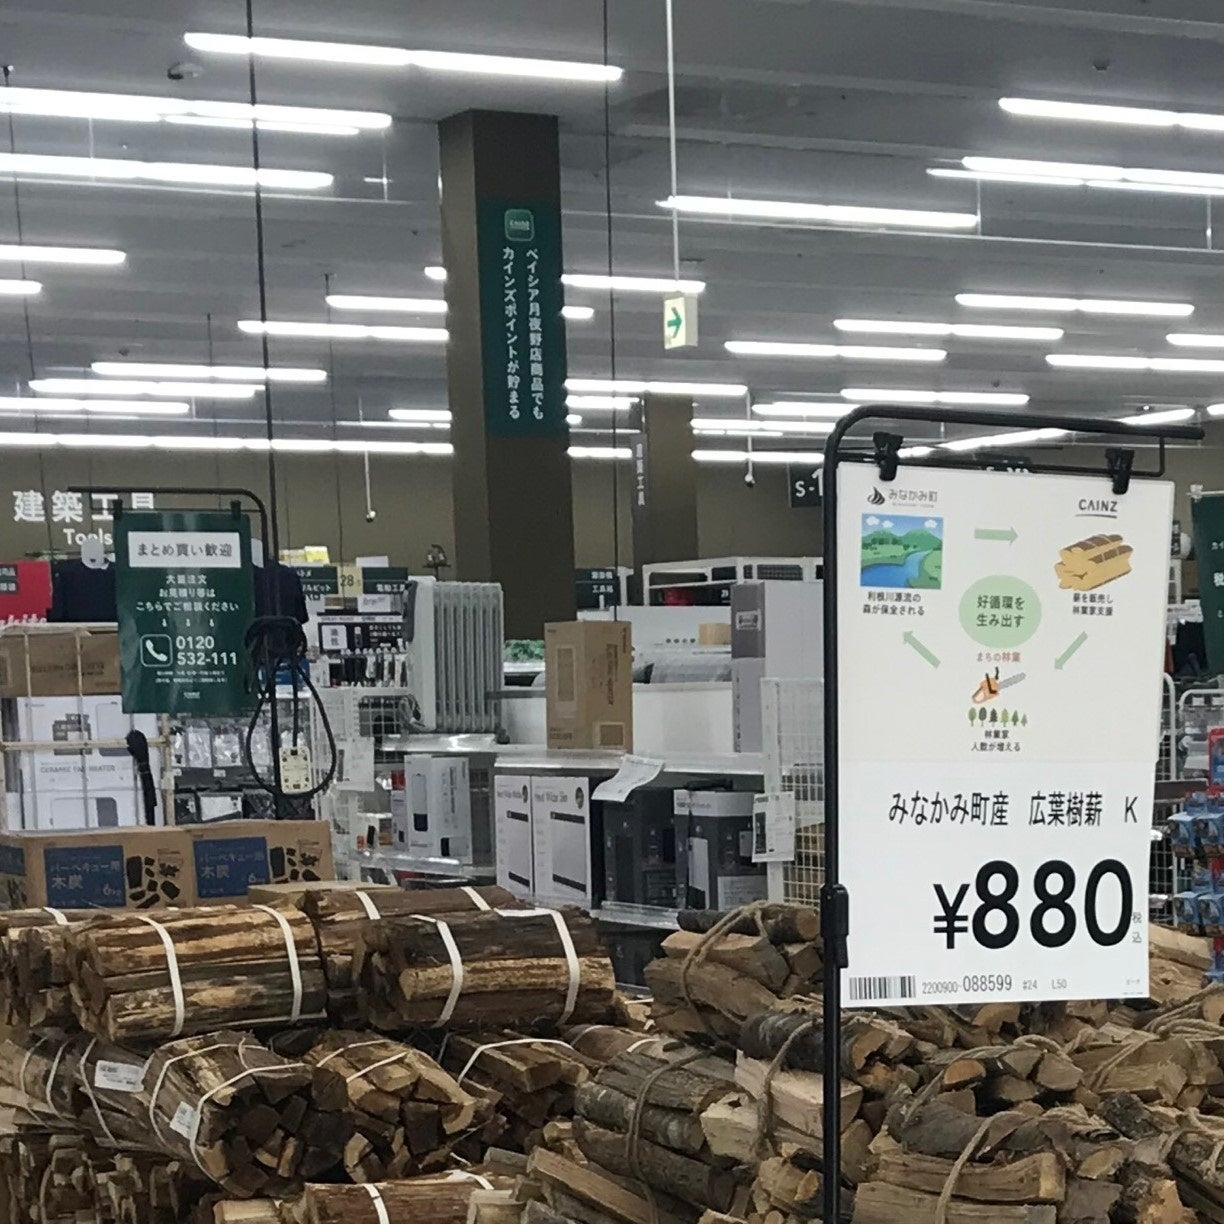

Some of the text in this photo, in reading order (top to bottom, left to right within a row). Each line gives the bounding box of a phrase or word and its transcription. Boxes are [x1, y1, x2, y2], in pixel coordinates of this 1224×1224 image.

[502, 247, 521, 420] カインズポイントが貯まる
[526, 248, 544, 420] ベイシア月夜野店商品でも
[888, 489, 938, 502] みなかみ町
[1079, 498, 1118, 513] CAINZ
[63, 528, 113, 545] Tools
[137, 543, 233, 557] まとめ買い歓迎
[339, 574, 354, 586] 28
[867, 590, 922, 602] 利根川源流の
[976, 594, 1025, 610] 好循環を
[862, 604, 925, 616] 森が保全される
[976, 614, 1025, 629] 生み出す
[175, 636, 215, 649] 0120
[176, 652, 238, 666] 532-111
[970, 741, 1021, 753] 人数が増える
[888, 790, 1139, 827] みなかみ町産 広葉樹薪 K
[932, 858, 1134, 950] ¥880
